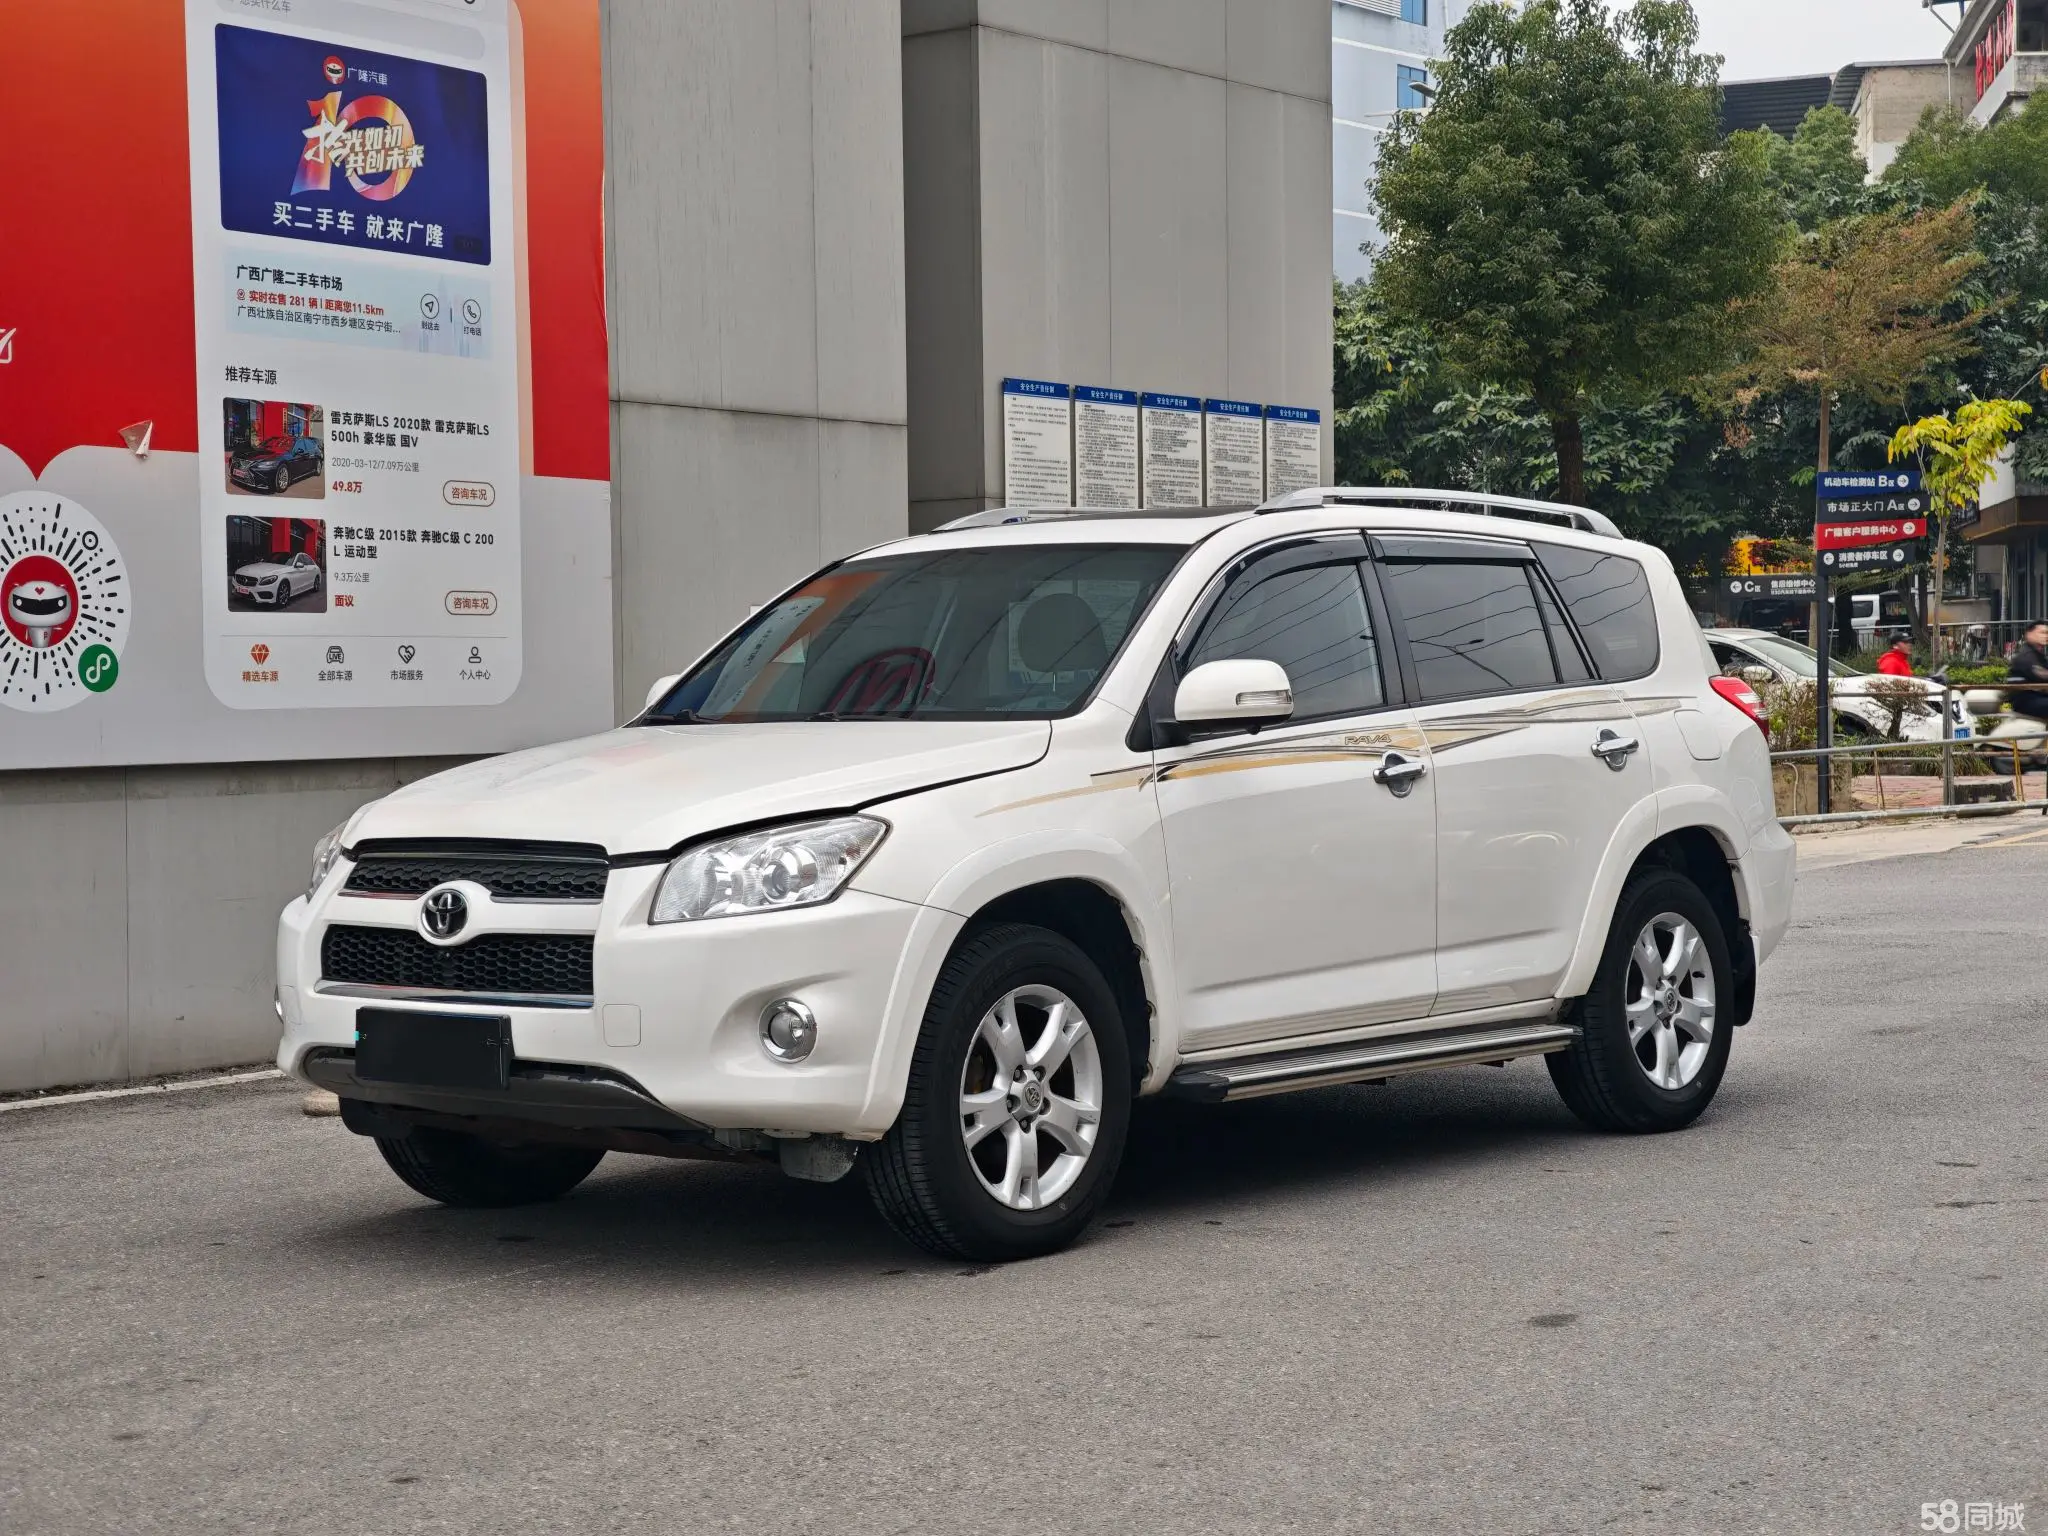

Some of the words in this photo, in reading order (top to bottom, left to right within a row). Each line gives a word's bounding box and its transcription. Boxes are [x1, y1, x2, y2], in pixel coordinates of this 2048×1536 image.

[345, 143, 425, 178] 共创未来
[273, 201, 354, 235] 买二手车
[366, 214, 444, 248] 就来广隆
[236, 265, 343, 291] 广西广隆二手车市场
[249, 290, 287, 306] 实时在售
[289, 295, 305, 307] 281
[308, 297, 318, 309] 辆
[463, 326, 482, 336] 打电话
[225, 366, 278, 386] 推荐车源
[331, 411, 389, 428] 雷克萨斯LS
[393, 416, 431, 432] 2020款
[435, 419, 490, 436] 雷克萨斯LS
[331, 430, 359, 443] 500h
[363, 431, 397, 447] 豪华版
[400, 434, 419, 448] 国V
[331, 457, 420, 473] 2020-03-12/7.09万公里
[332, 480, 363, 494] 49.8万
[1824, 477, 1876, 487] 机动车检测站
[451, 486, 488, 501] 咨询车况
[1827, 501, 1884, 513] 市场正大门
[333, 526, 375, 541] 奔驰C级
[379, 529, 417, 543] 2015款
[421, 530, 460, 545] 奔驰C级
[463, 533, 471, 544] C
[475, 533, 494, 545] 200
[333, 545, 340, 557] L
[344, 544, 378, 559] 运动型
[334, 572, 370, 583] 9.3万公里
[334, 594, 354, 607] 面议
[453, 597, 490, 610] 咨询车况
[242, 670, 279, 682] 精选车源
[318, 670, 353, 682] 全部车源
[390, 669, 424, 682] 市场服务
[459, 669, 491, 681] 个人中心
[1344, 733, 1392, 745] RAV4
